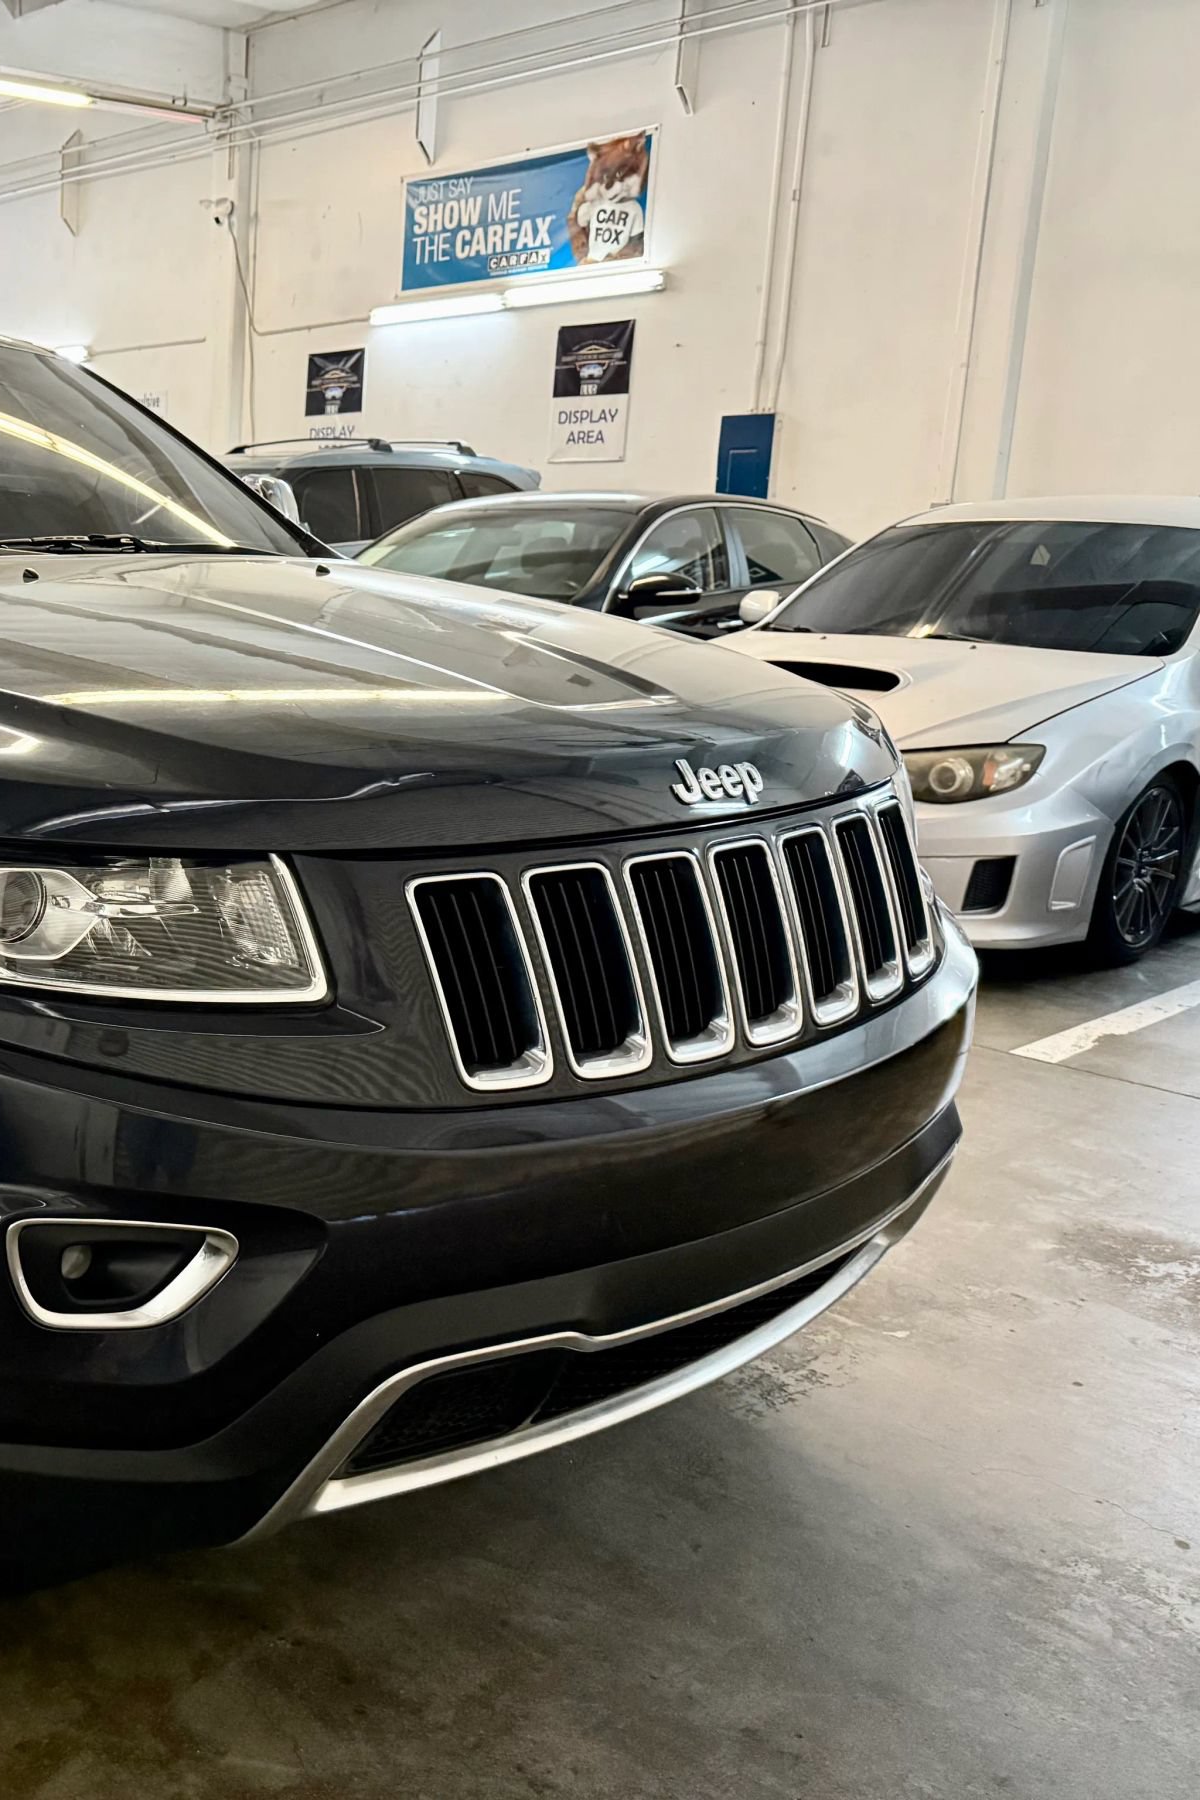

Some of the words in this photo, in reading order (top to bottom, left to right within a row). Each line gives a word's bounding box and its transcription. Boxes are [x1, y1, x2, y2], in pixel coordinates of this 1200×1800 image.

[415, 181, 445, 203] JUST
[449, 177, 474, 198] SAY
[413, 196, 482, 235] SHOW
[488, 188, 522, 223] ME
[596, 209, 629, 227] CAR
[412, 232, 452, 265] THE
[455, 215, 553, 260] CARFAX
[594, 227, 624, 245] FOX
[489, 250, 550, 271] CARFAX
[558, 408, 619, 425] DISPLAY
[309, 425, 355, 440] DISPLAY
[566, 430, 605, 445] AREA
[669, 758, 764, 805] Jeep
